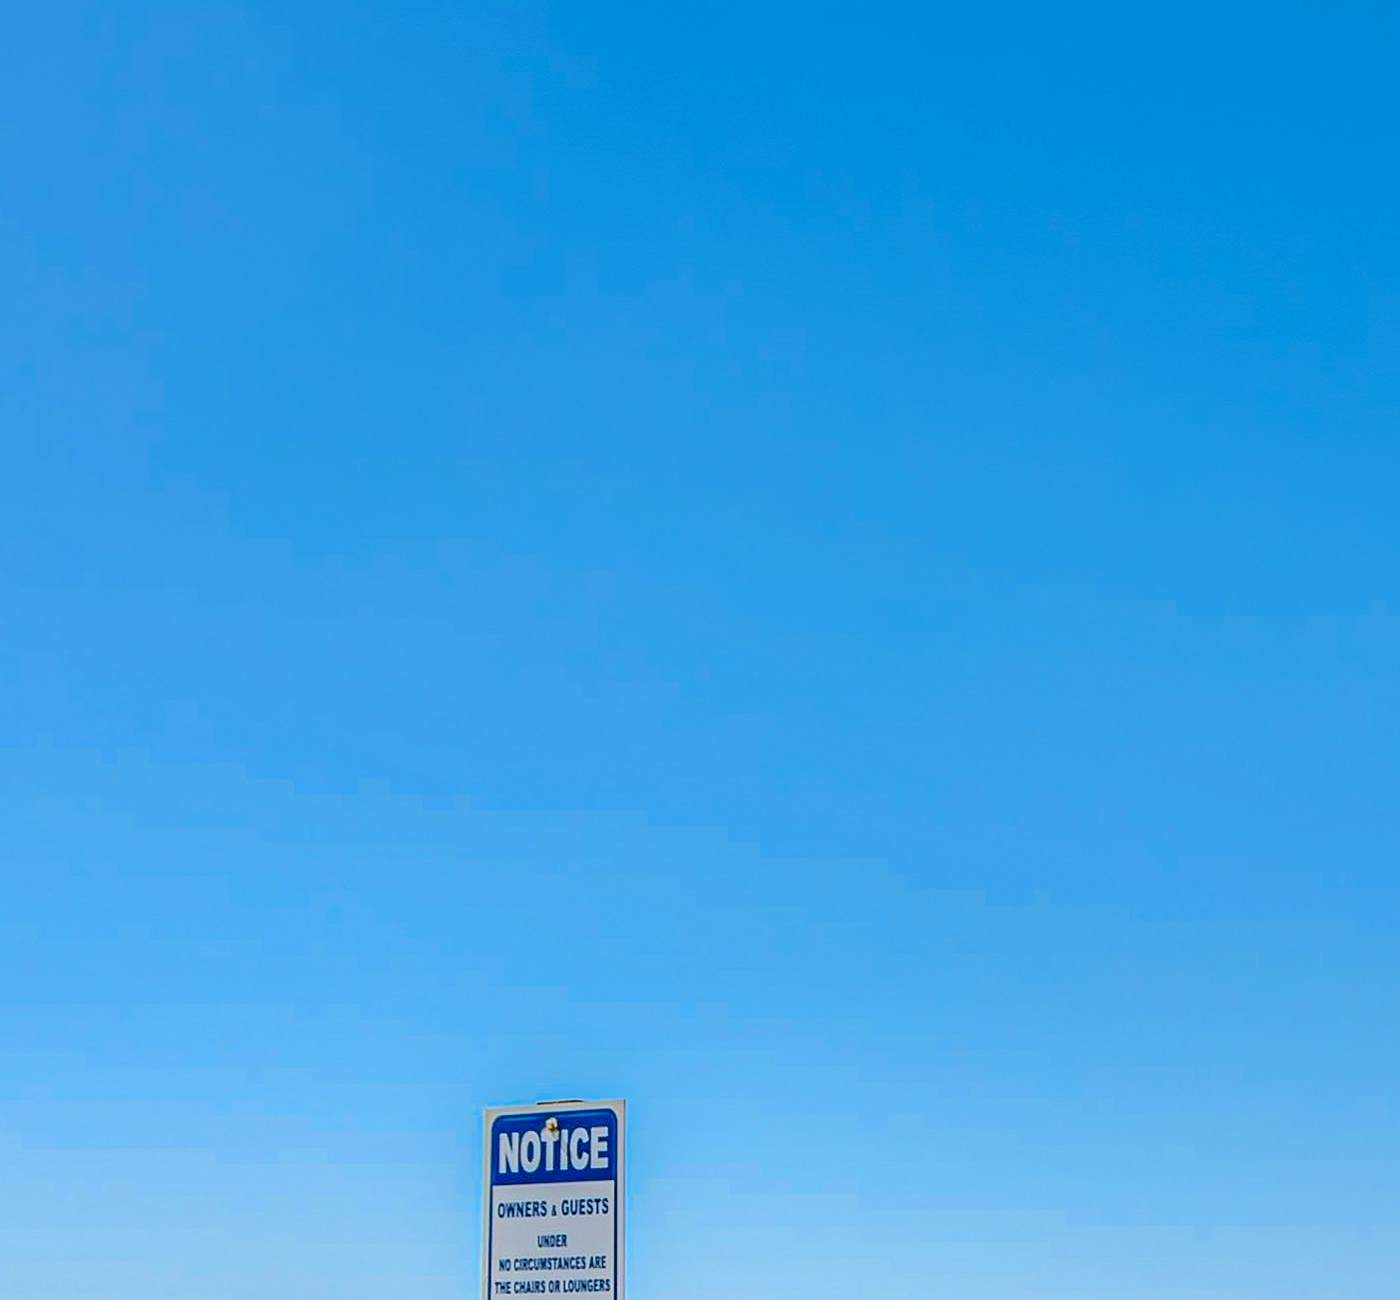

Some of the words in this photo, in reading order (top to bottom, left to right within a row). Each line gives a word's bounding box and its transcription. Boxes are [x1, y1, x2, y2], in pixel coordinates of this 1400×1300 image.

[498, 1126, 609, 1174] NOTICE
[497, 1201, 548, 1218] OWNERS
[561, 1198, 609, 1216] GUESTS
[537, 1234, 568, 1248] UNDER
[499, 1259, 512, 1272] NO
[514, 1256, 587, 1271] CIRCUMSTANCES
[589, 1256, 607, 1269] ARE
[495, 1281, 512, 1294] THE
[514, 1280, 546, 1294] CHAIRS
[548, 1280, 561, 1293] OR
[563, 1278, 611, 1293] LOUNGERS
